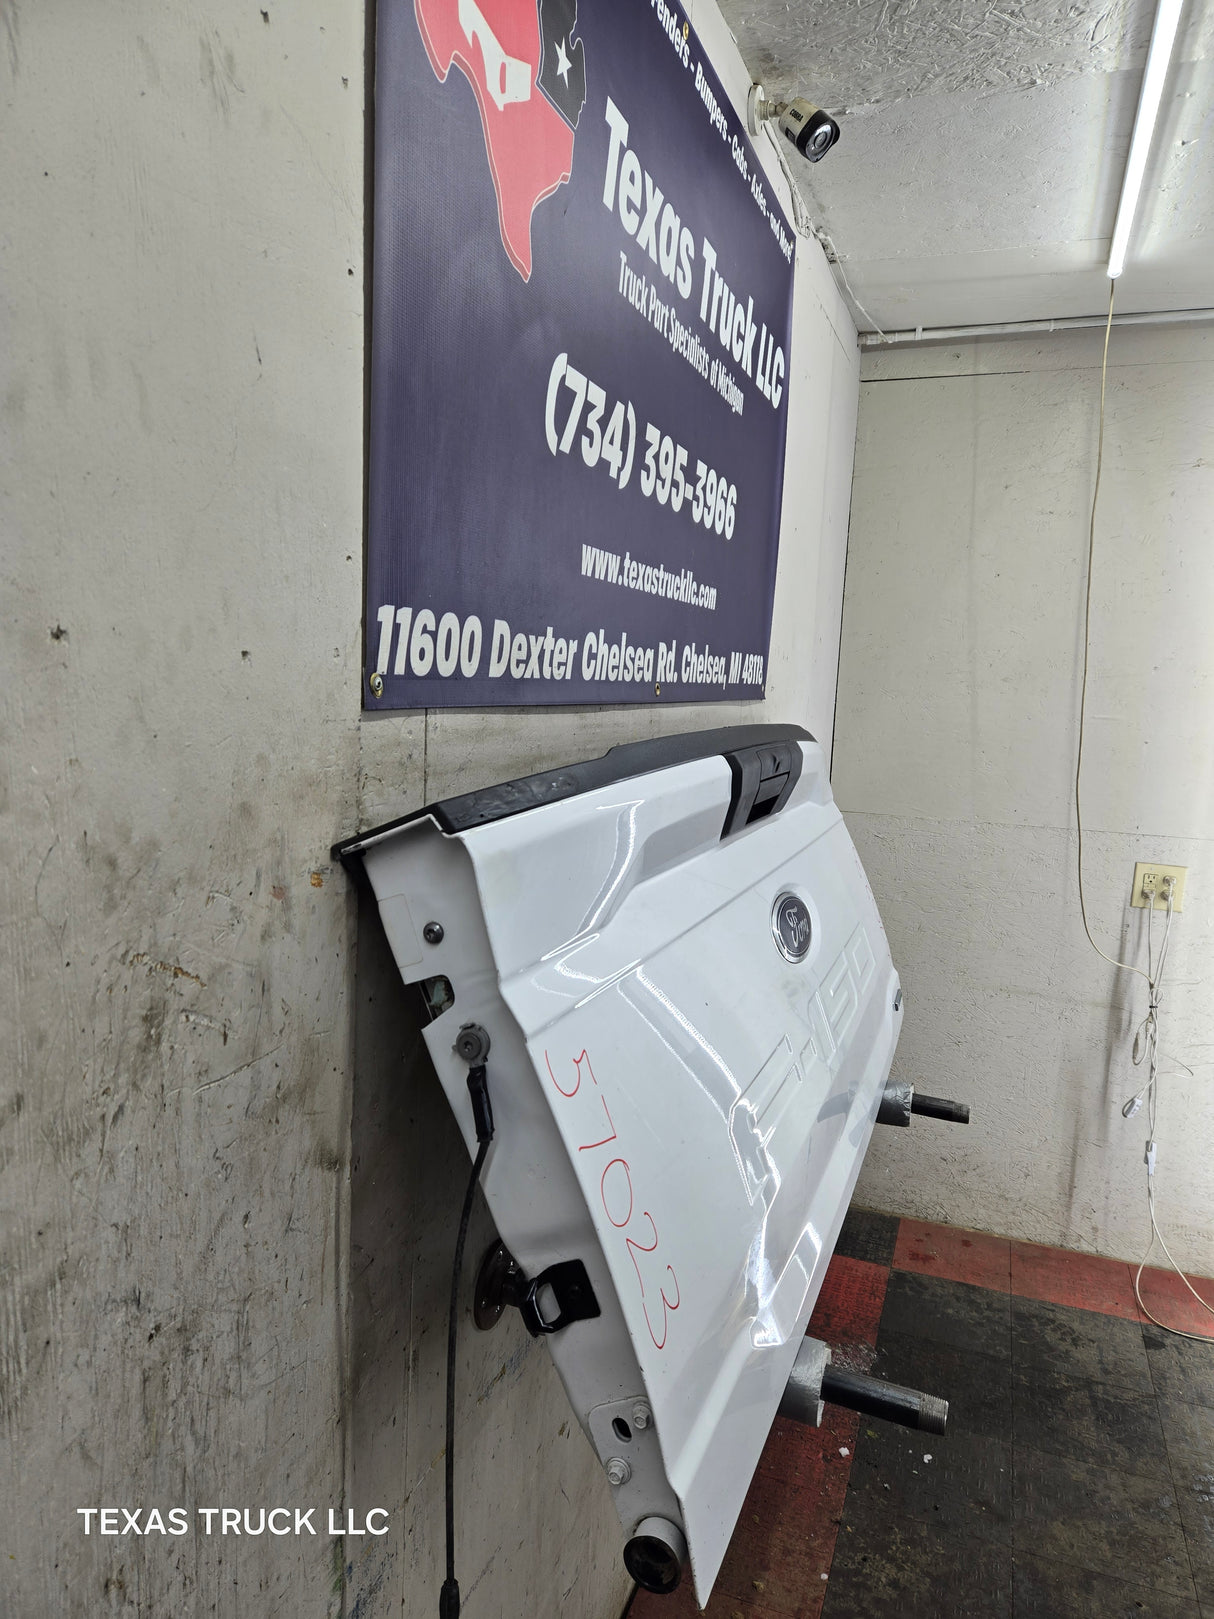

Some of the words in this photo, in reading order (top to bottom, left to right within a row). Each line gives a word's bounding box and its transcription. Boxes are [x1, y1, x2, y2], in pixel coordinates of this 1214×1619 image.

[651, 0, 690, 68] enders
[695, 61, 728, 141] Bumpers
[731, 134, 748, 180] Cabs
[602, 96, 695, 299] Texas
[700, 237, 758, 378] Truck
[755, 322, 785, 409] LLC
[618, 250, 649, 318] Truck
[648, 284, 669, 339] Part
[669, 307, 710, 375] Specialists
[710, 358, 719, 389] of
[717, 361, 744, 416] Michigan
[545, 352, 636, 489] (734)
[640, 422, 737, 540] 395-3966
[376, 604, 483, 678] 11600
[488, 618, 578, 680] Dexter
[581, 628, 654, 682] Chelsea
[656, 640, 678, 683] Rd.
[681, 642, 727, 690] Chelsea,
[728, 651, 743, 684] MI
[741, 653, 764, 685] 48118
[581, 543, 717, 610] www.texastruckllc.com
[785, 904, 811, 948] Ford
[545, 1049, 680, 1349] 57023
